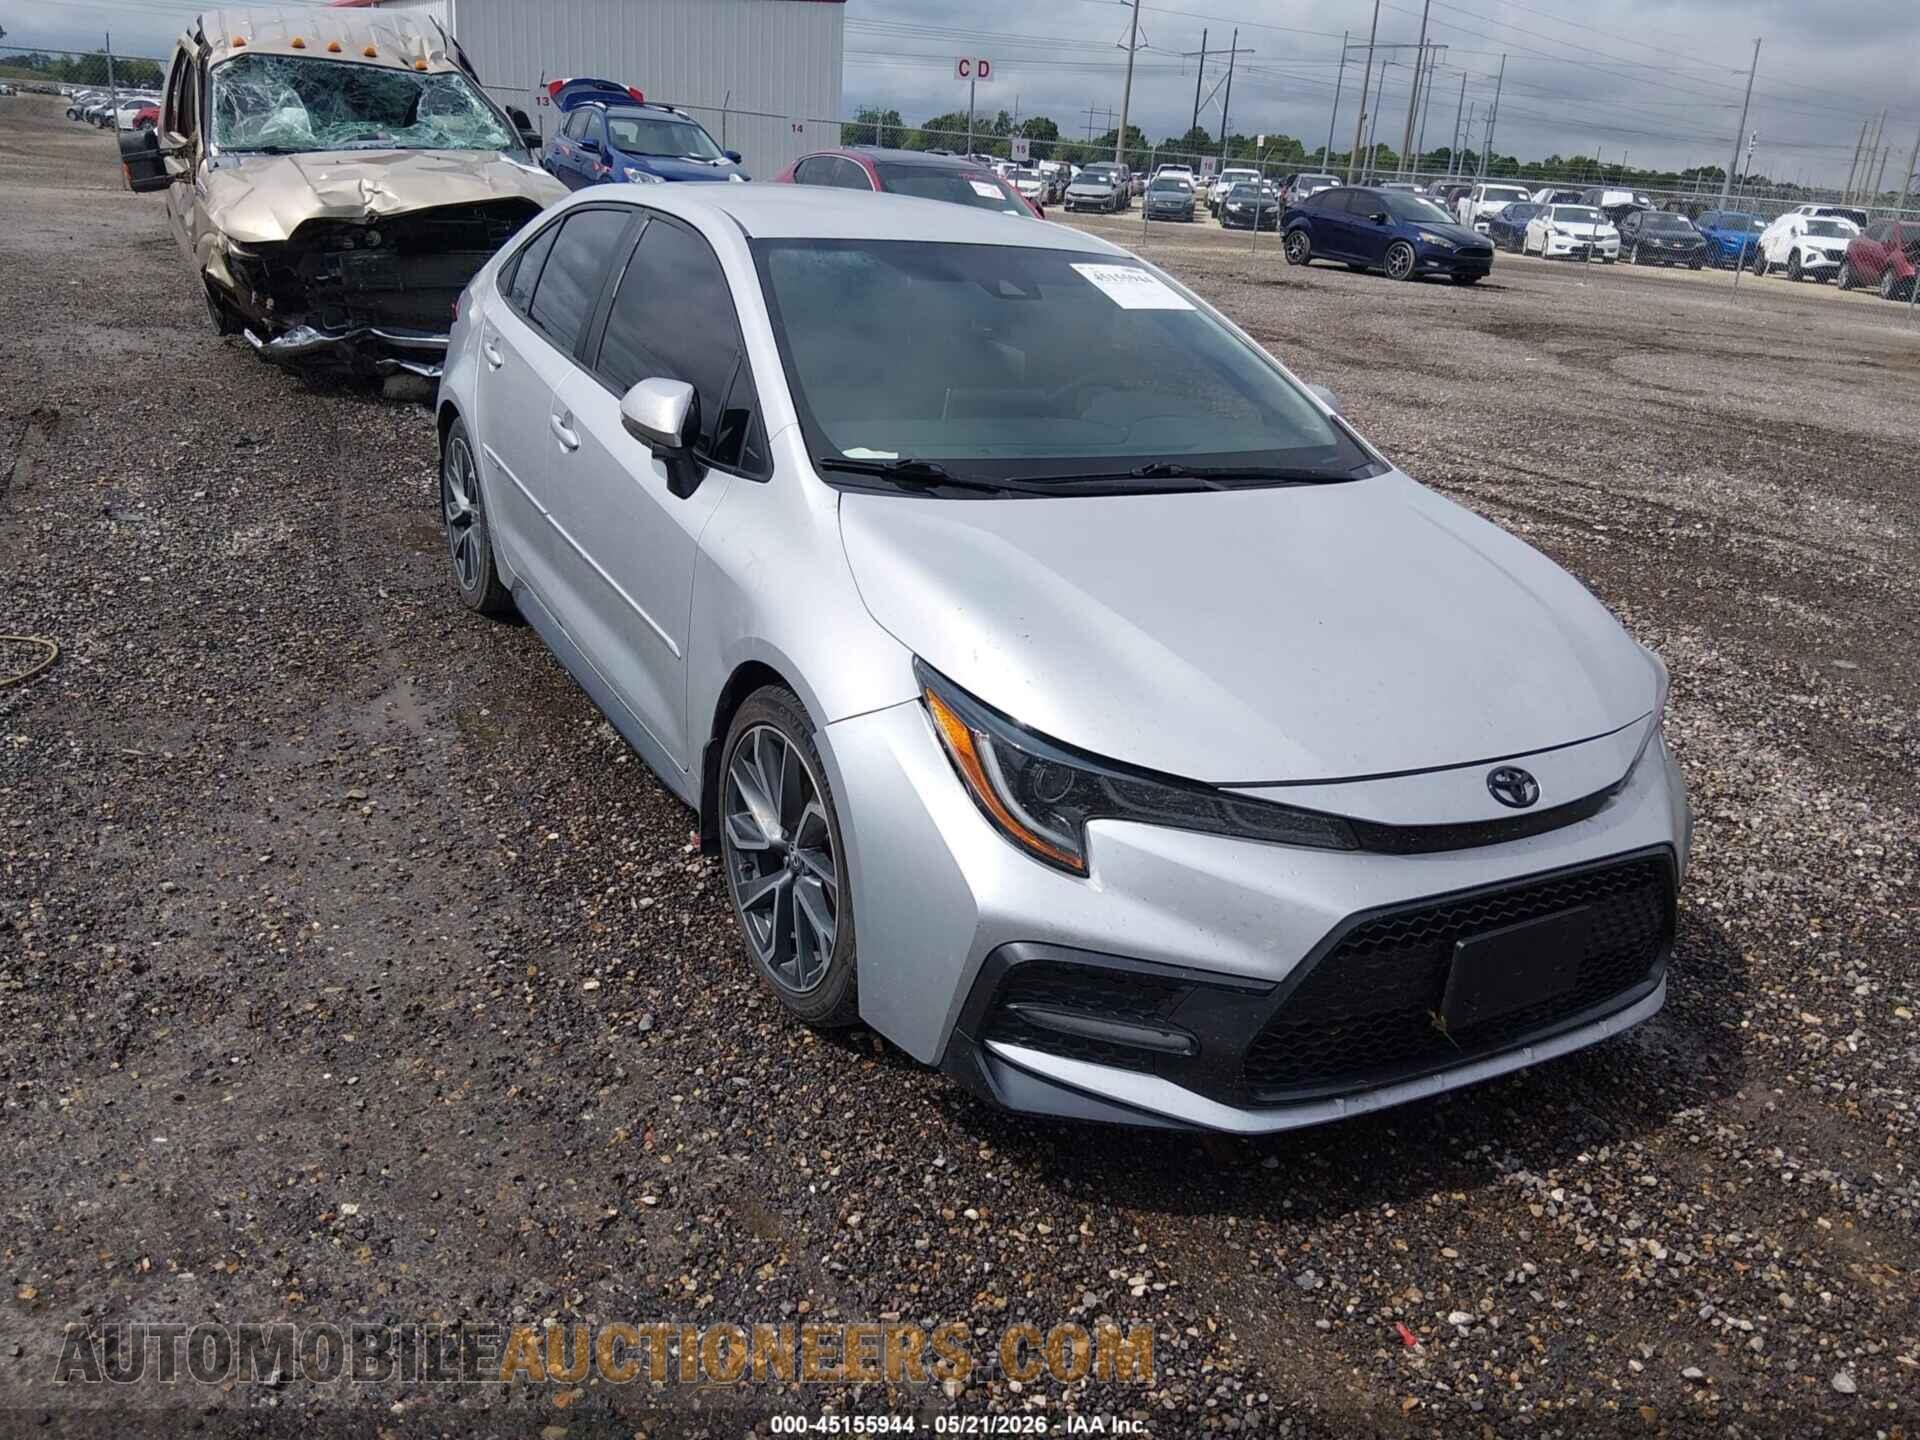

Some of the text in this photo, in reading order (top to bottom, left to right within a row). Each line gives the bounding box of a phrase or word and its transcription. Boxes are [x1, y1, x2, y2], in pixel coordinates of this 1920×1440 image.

[959, 59, 989, 78] C D
[535, 96, 550, 106] 13
[791, 123, 804, 133] 14
